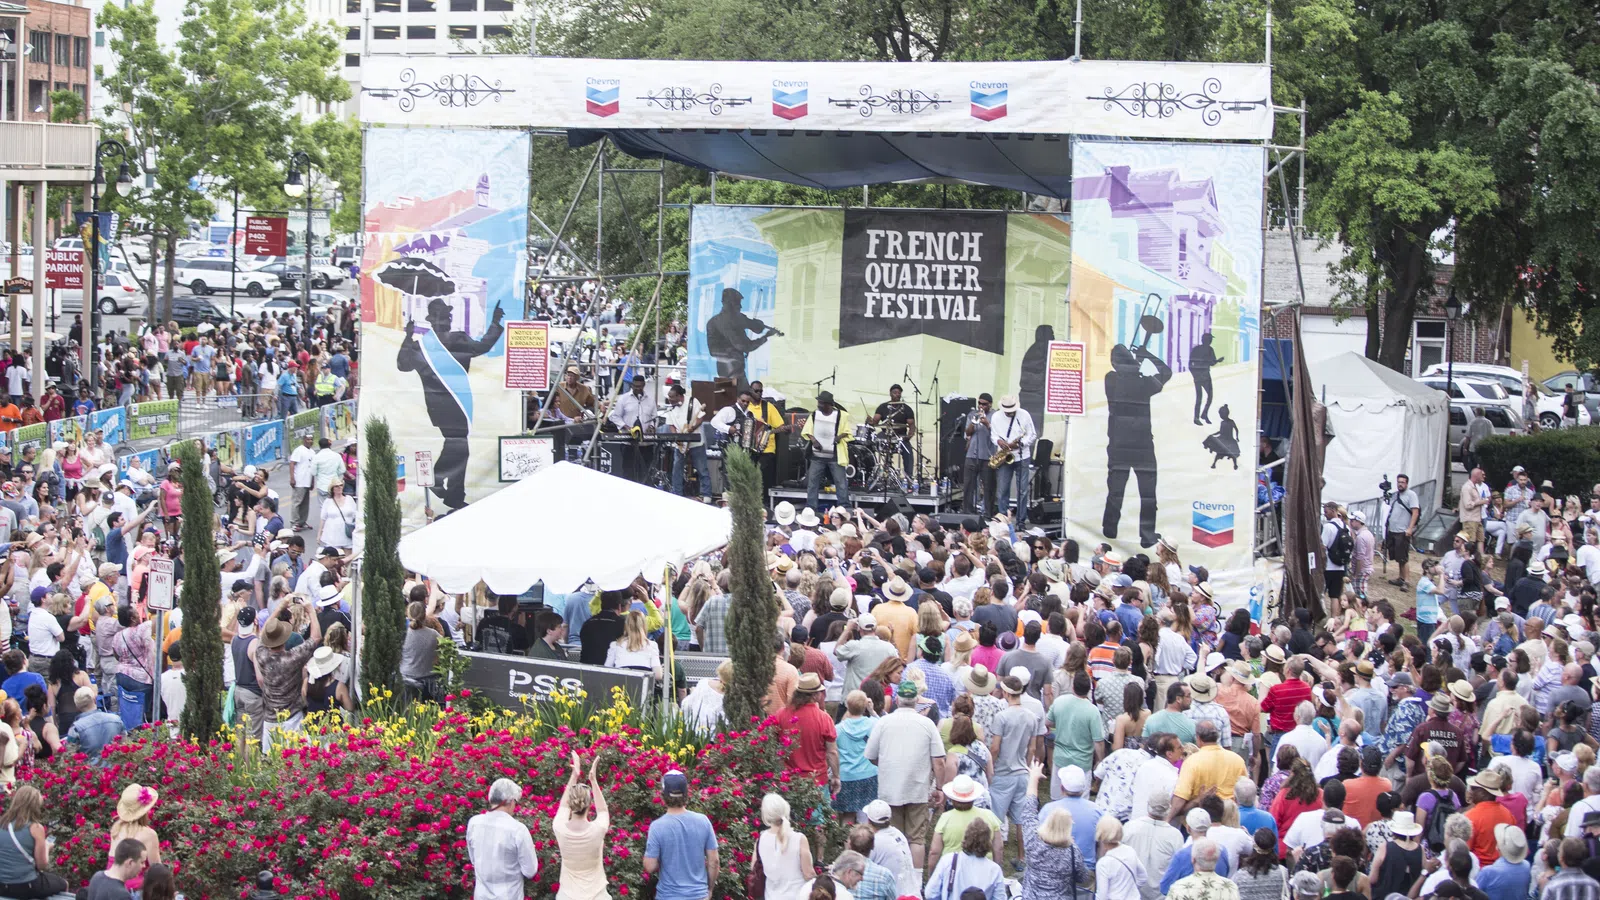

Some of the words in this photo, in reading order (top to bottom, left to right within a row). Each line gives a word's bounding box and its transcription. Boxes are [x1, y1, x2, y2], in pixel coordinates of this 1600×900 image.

[586, 77, 620, 85] Chevron
[772, 79, 808, 87] Chevron
[970, 80, 1008, 89] Chevron
[865, 229, 983, 262] FRENCH
[45, 252, 79, 262] PUBLIC
[865, 262, 983, 293] QUARTER
[864, 292, 981, 322] FESTIVAL
[1192, 500, 1235, 511] Chevron
[155, 575, 167, 584] ANY
[508, 668, 584, 698] PSS
[1430, 730, 1457, 739] HARLEY-
